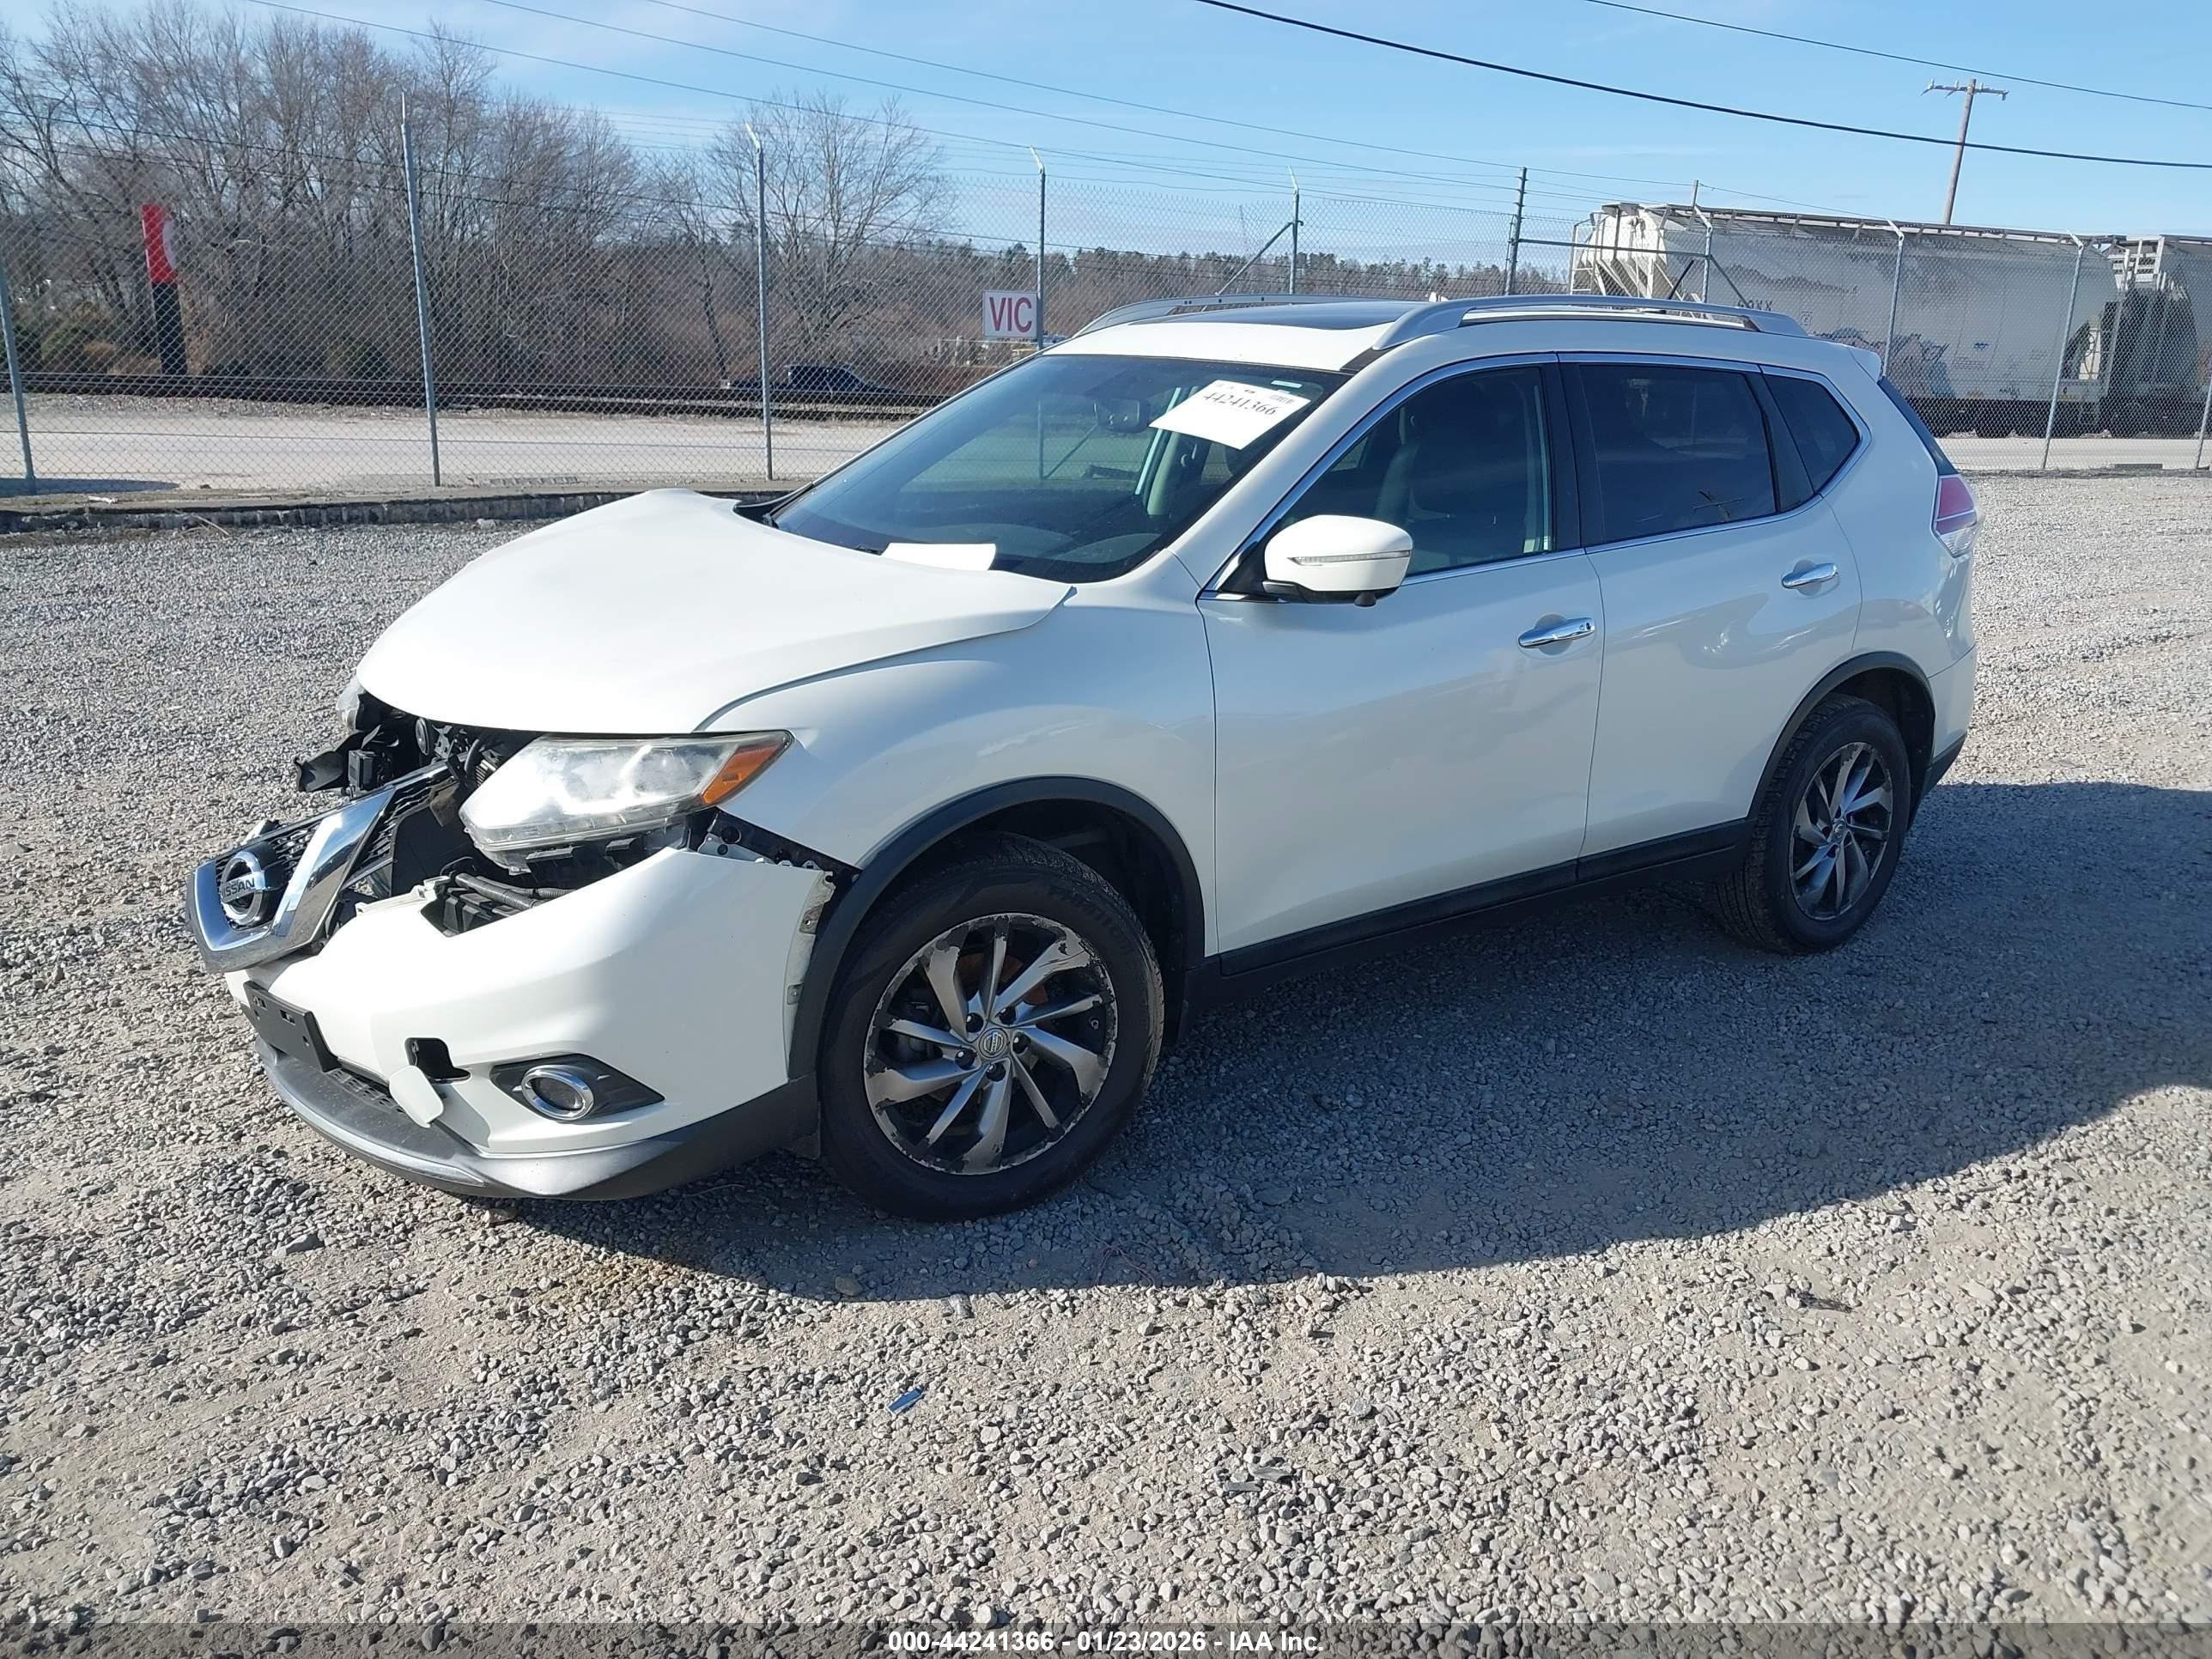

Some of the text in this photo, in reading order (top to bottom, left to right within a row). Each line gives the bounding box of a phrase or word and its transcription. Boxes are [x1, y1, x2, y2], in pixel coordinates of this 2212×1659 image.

[989, 296, 1032, 333] VIC
[1203, 392, 1279, 416] 44241366
[222, 877, 256, 897] ISSAN
